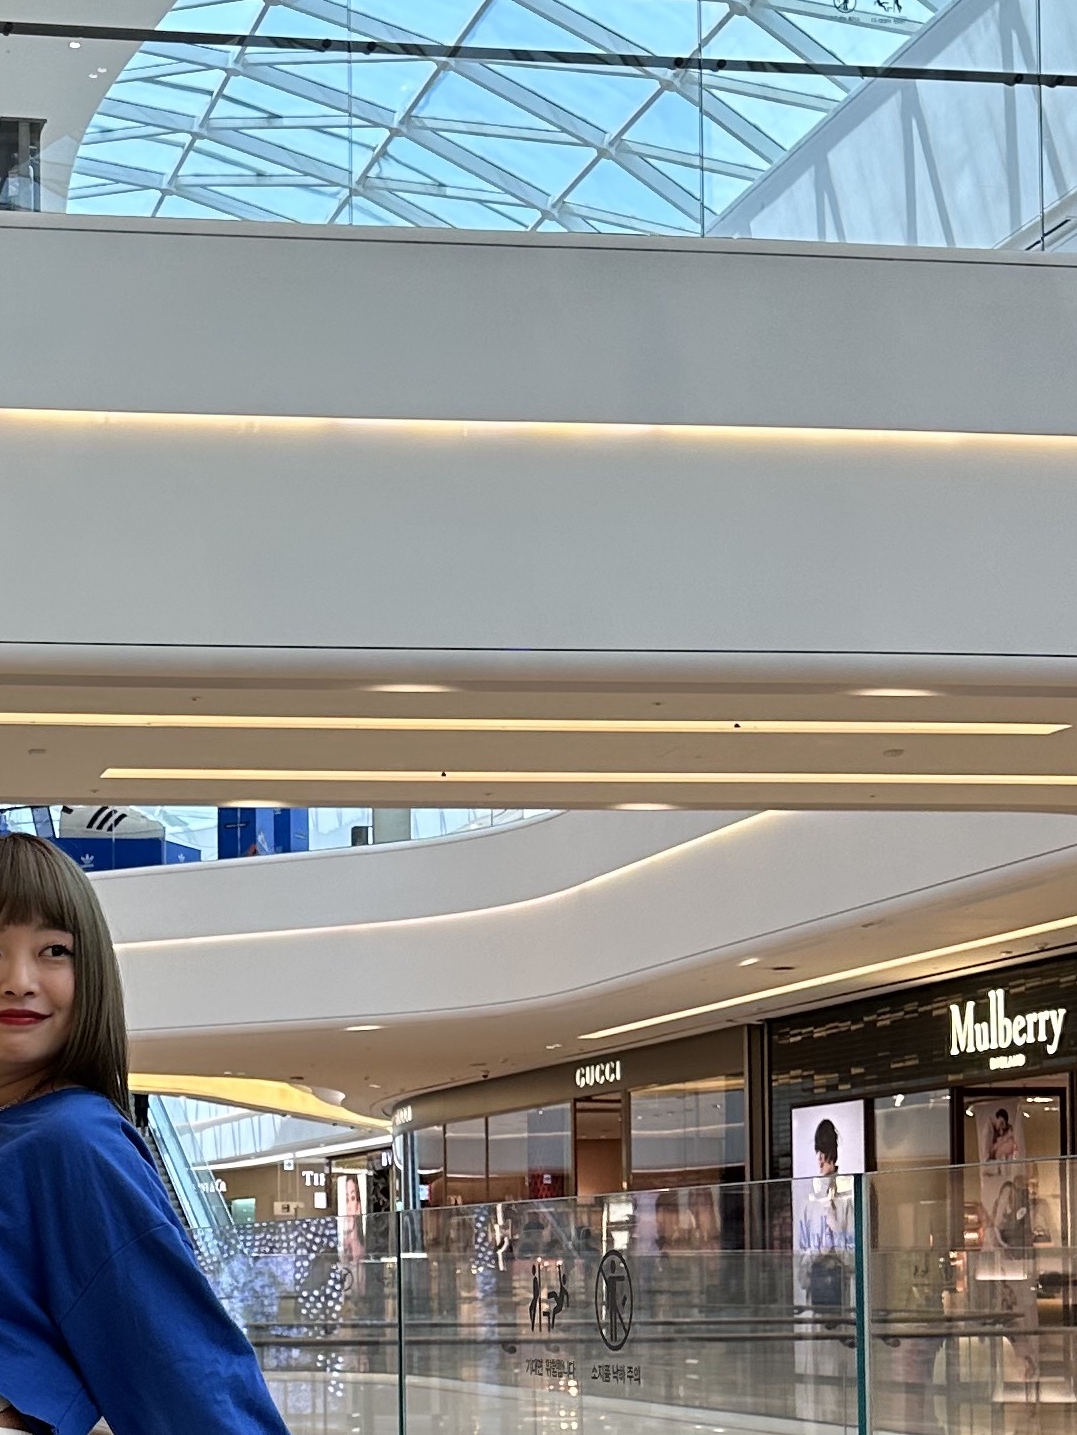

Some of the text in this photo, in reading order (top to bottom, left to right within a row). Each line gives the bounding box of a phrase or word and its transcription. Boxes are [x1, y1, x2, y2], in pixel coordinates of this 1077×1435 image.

[949, 987, 1067, 1056] Mulberry
[575, 1060, 622, 1089] GUCCI
[626, 1364, 642, 1387] 주의
